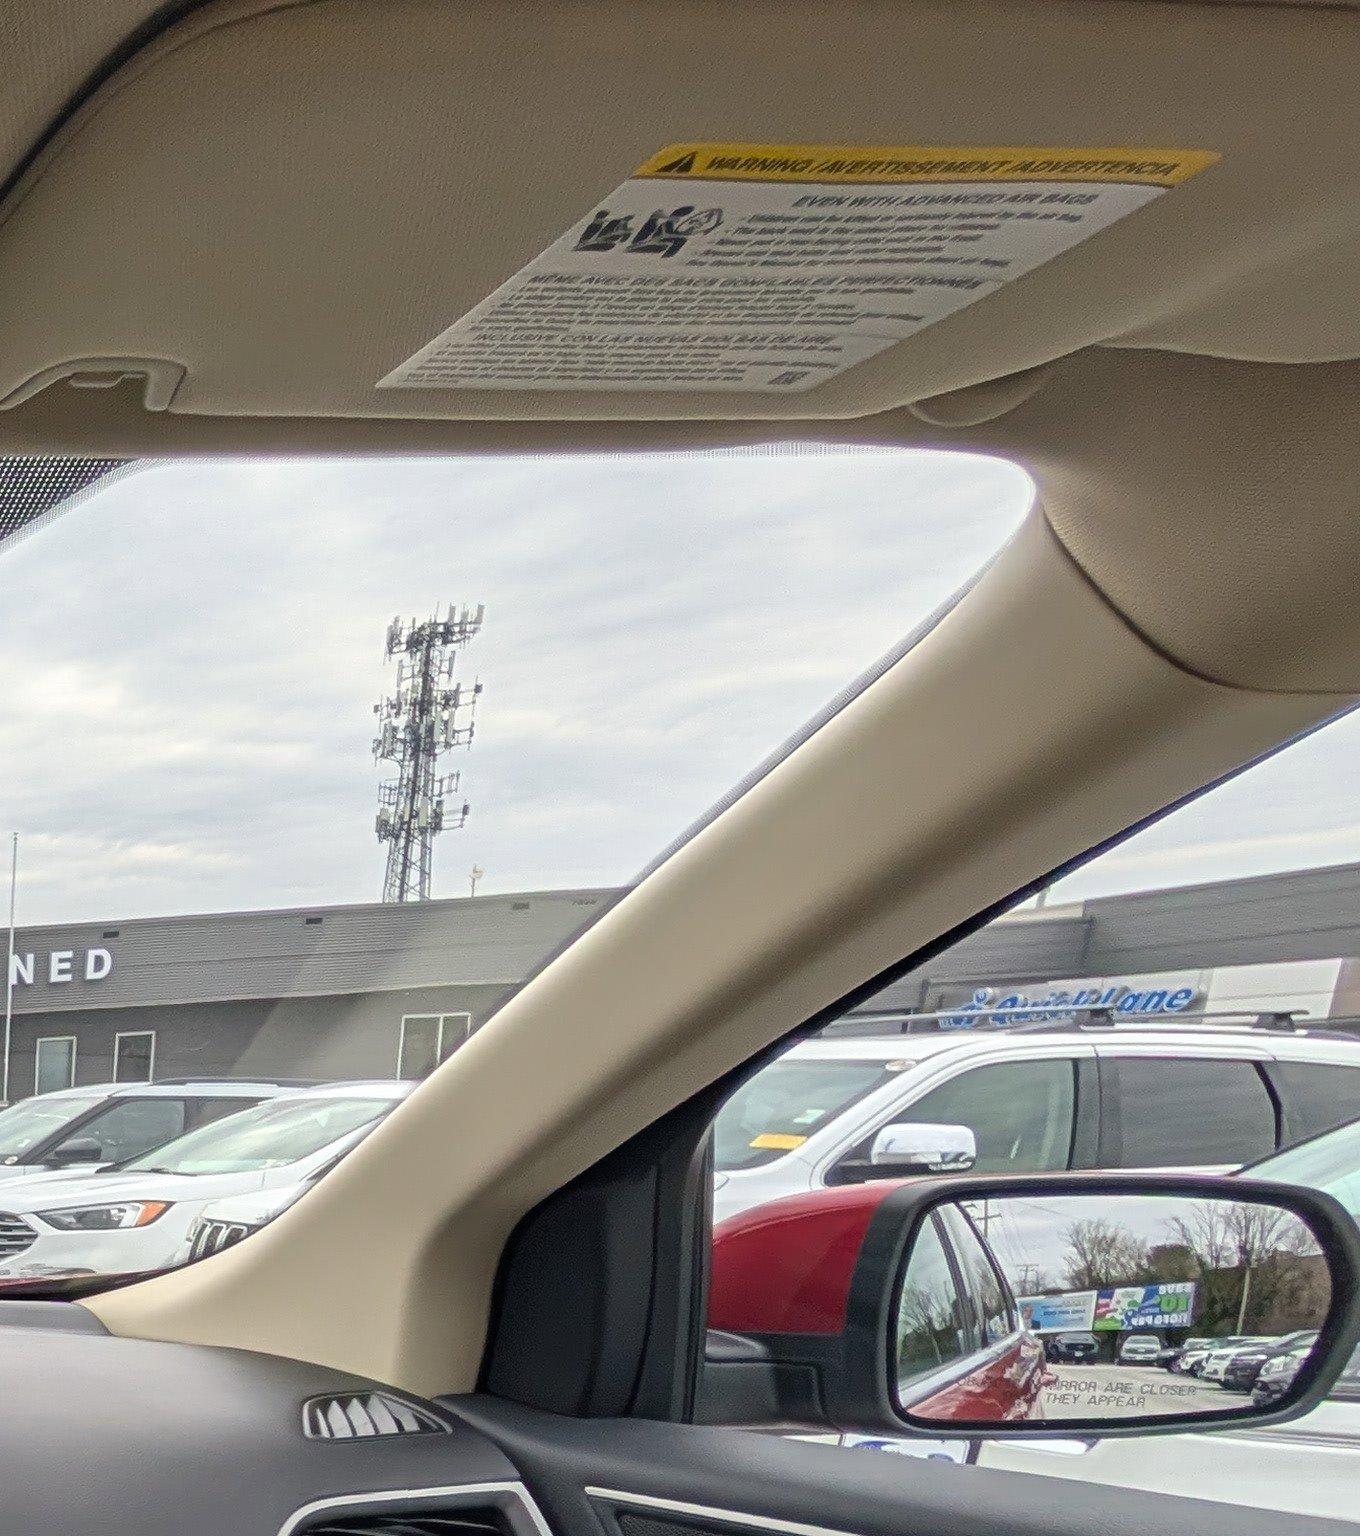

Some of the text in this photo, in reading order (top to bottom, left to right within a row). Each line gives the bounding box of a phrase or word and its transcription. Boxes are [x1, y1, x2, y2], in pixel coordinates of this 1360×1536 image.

[704, 155, 814, 175] WARNING
[1103, 1382, 1135, 1395] ARE
[1140, 1383, 1197, 1397] CLOSER
[1045, 1392, 1146, 1408] THEY APPEAR
